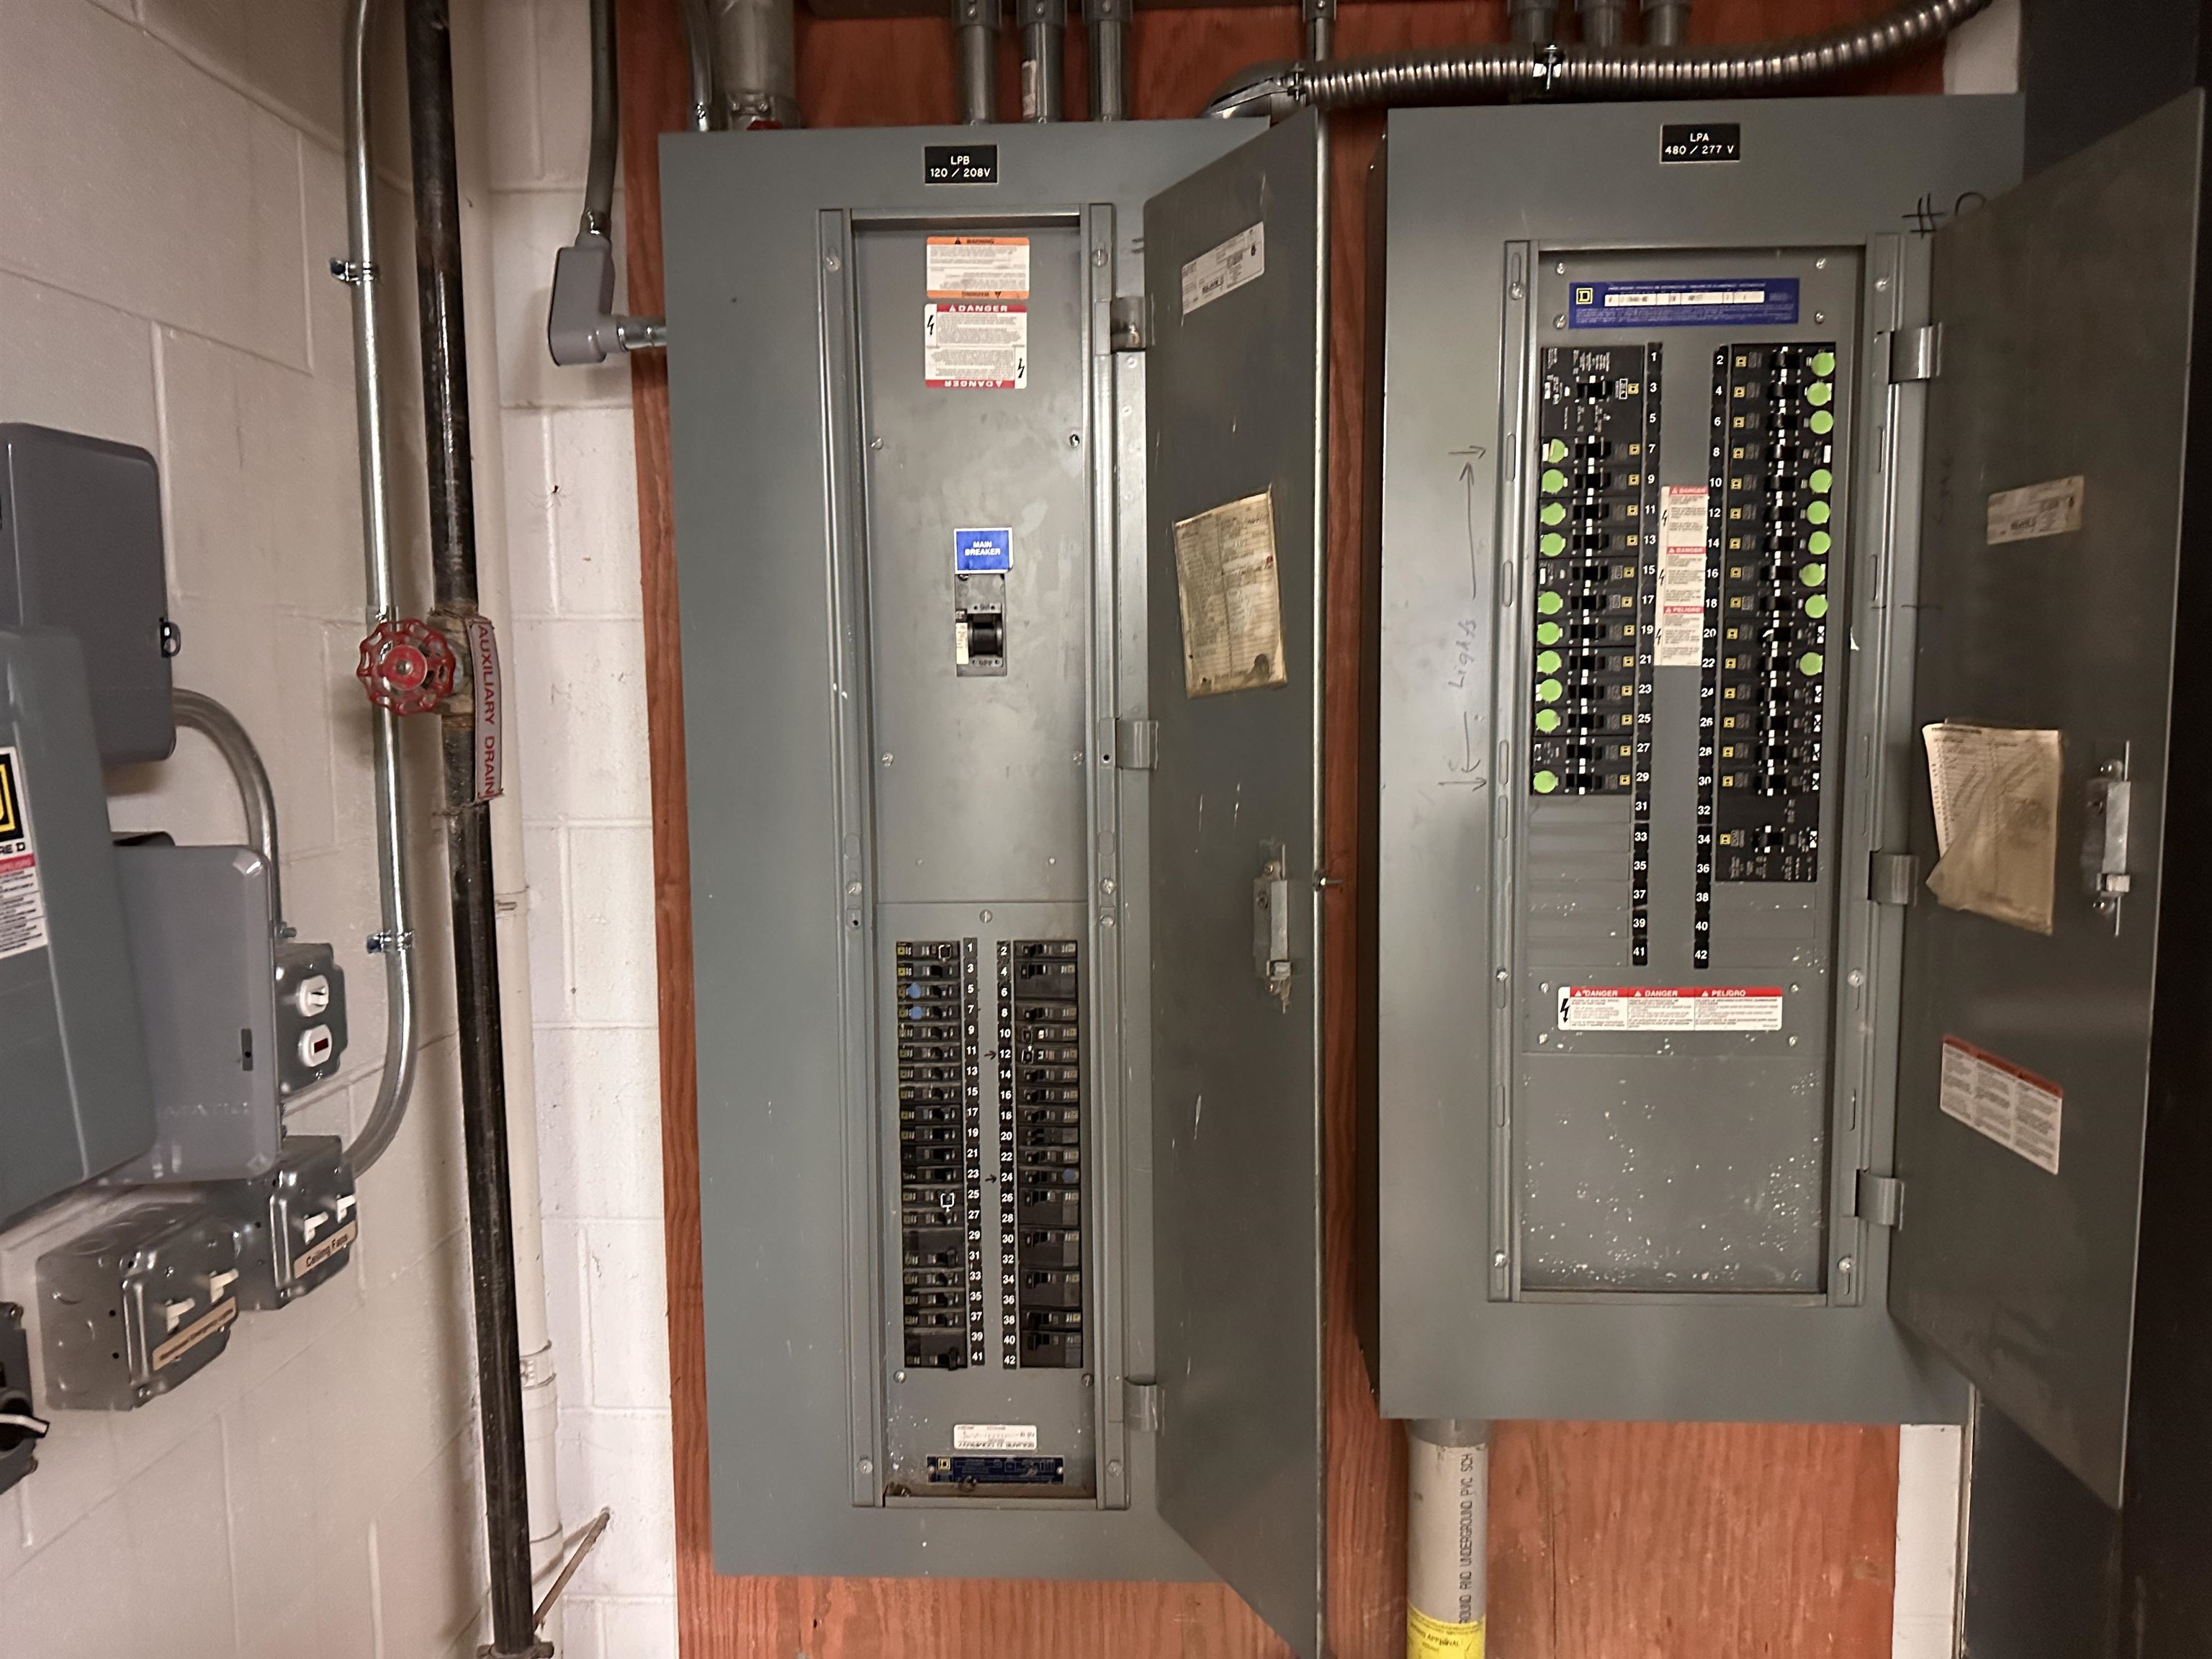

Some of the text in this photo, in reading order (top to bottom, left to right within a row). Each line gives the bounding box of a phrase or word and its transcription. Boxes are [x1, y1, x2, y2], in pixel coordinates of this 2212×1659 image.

[1689, 132, 1709, 143] LPA
[1665, 145, 1735, 155] 480 / 277 V
[950, 156, 970, 166] LPB
[930, 167, 992, 178] 120 / 208V
[1651, 352, 1657, 361] 1
[1717, 355, 1724, 365] 2
[1650, 382, 1657, 392] 3
[1715, 385, 1722, 396] 4
[1649, 413, 1656, 423] 5
[1714, 416, 1721, 426] 6
[1648, 444, 1656, 454] 7
[1712, 447, 1720, 457] 8
[1647, 474, 1655, 484] 9
[1709, 477, 1722, 487] 10
[1645, 505, 1655, 514] 11
[1709, 508, 1721, 518] 12
[1643, 534, 1656, 545] 13
[1708, 538, 1719, 548] 14
[1642, 565, 1655, 575] 15
[1707, 568, 1719, 578] 16
[1642, 595, 1655, 605] 17
[1705, 598, 1717, 608] 18
[1641, 624, 1654, 634] 19
[1703, 628, 1717, 638] 20
[1639, 654, 1652, 665] 21
[1701, 657, 1715, 668] 22
[1638, 683, 1652, 694] 23
[477, 625, 495, 795] AUXILIARY DRAIN
[1637, 714, 1651, 724] 25
[1699, 717, 1713, 727] 26
[1637, 742, 1650, 752] 27
[1636, 772, 1650, 782] 29
[1698, 776, 1712, 786] 30
[1635, 801, 1647, 811] 31
[1697, 805, 1711, 815] 32
[1635, 832, 1647, 842] 33
[1698, 834, 1711, 844] 34
[16, 842, 26, 852] D
[1634, 860, 1647, 871] 35
[1696, 863, 1710, 873] 36
[1633, 889, 1646, 899] 37
[1696, 892, 1709, 902] 38
[1633, 918, 1646, 928] 39
[1695, 921, 1709, 931] 40
[967, 943, 973, 953] 1
[1000, 946, 1007, 956] 2
[1633, 947, 1645, 956] 41
[1694, 950, 1707, 960] 42
[967, 963, 974, 974] 3
[1000, 966, 1007, 976] 4
[967, 984, 974, 994] 5
[1001, 987, 1008, 997] 6
[967, 1004, 975, 1014] 7
[1001, 1008, 1008, 1017] 8
[968, 1025, 975, 1035] 9
[999, 1028, 1011, 1038] 10
[966, 1046, 976, 1056] 11
[999, 1049, 1011, 1058] 12
[966, 1066, 978, 1076] 13
[999, 1069, 1012, 1079] 14
[967, 1087, 979, 1097] 15
[1000, 1090, 1012, 1100] 16
[967, 1107, 979, 1117] 17
[1000, 1111, 1012, 1120] 18
[967, 1128, 979, 1138] 19
[1000, 1131, 1012, 1141] 20
[966, 1148, 978, 1158] 21
[1001, 1151, 1013, 1161] 22
[967, 1169, 979, 1179] 23
[1001, 1172, 1013, 1182] 24
[967, 1189, 980, 1199] 25
[1001, 1192, 1014, 1202] 26
[968, 1210, 980, 1220] 27
[1002, 1213, 1014, 1223] 28
[968, 1230, 981, 1240] 29
[1002, 1233, 1014, 1244] 30
[968, 1251, 980, 1261] 31
[1002, 1254, 1015, 1264] 32
[969, 1271, 981, 1281] 33
[1002, 1274, 1015, 1285] 34
[970, 1291, 982, 1301] 35
[1002, 1295, 1015, 1305] 36
[971, 1311, 983, 1321] 37
[1003, 1315, 1015, 1325] 38
[971, 1331, 984, 1341] 39
[1003, 1335, 1016, 1345] 40
[971, 1352, 983, 1361] 41
[1004, 1355, 1016, 1365] 42
[1461, 1477, 1473, 1496] PVC
